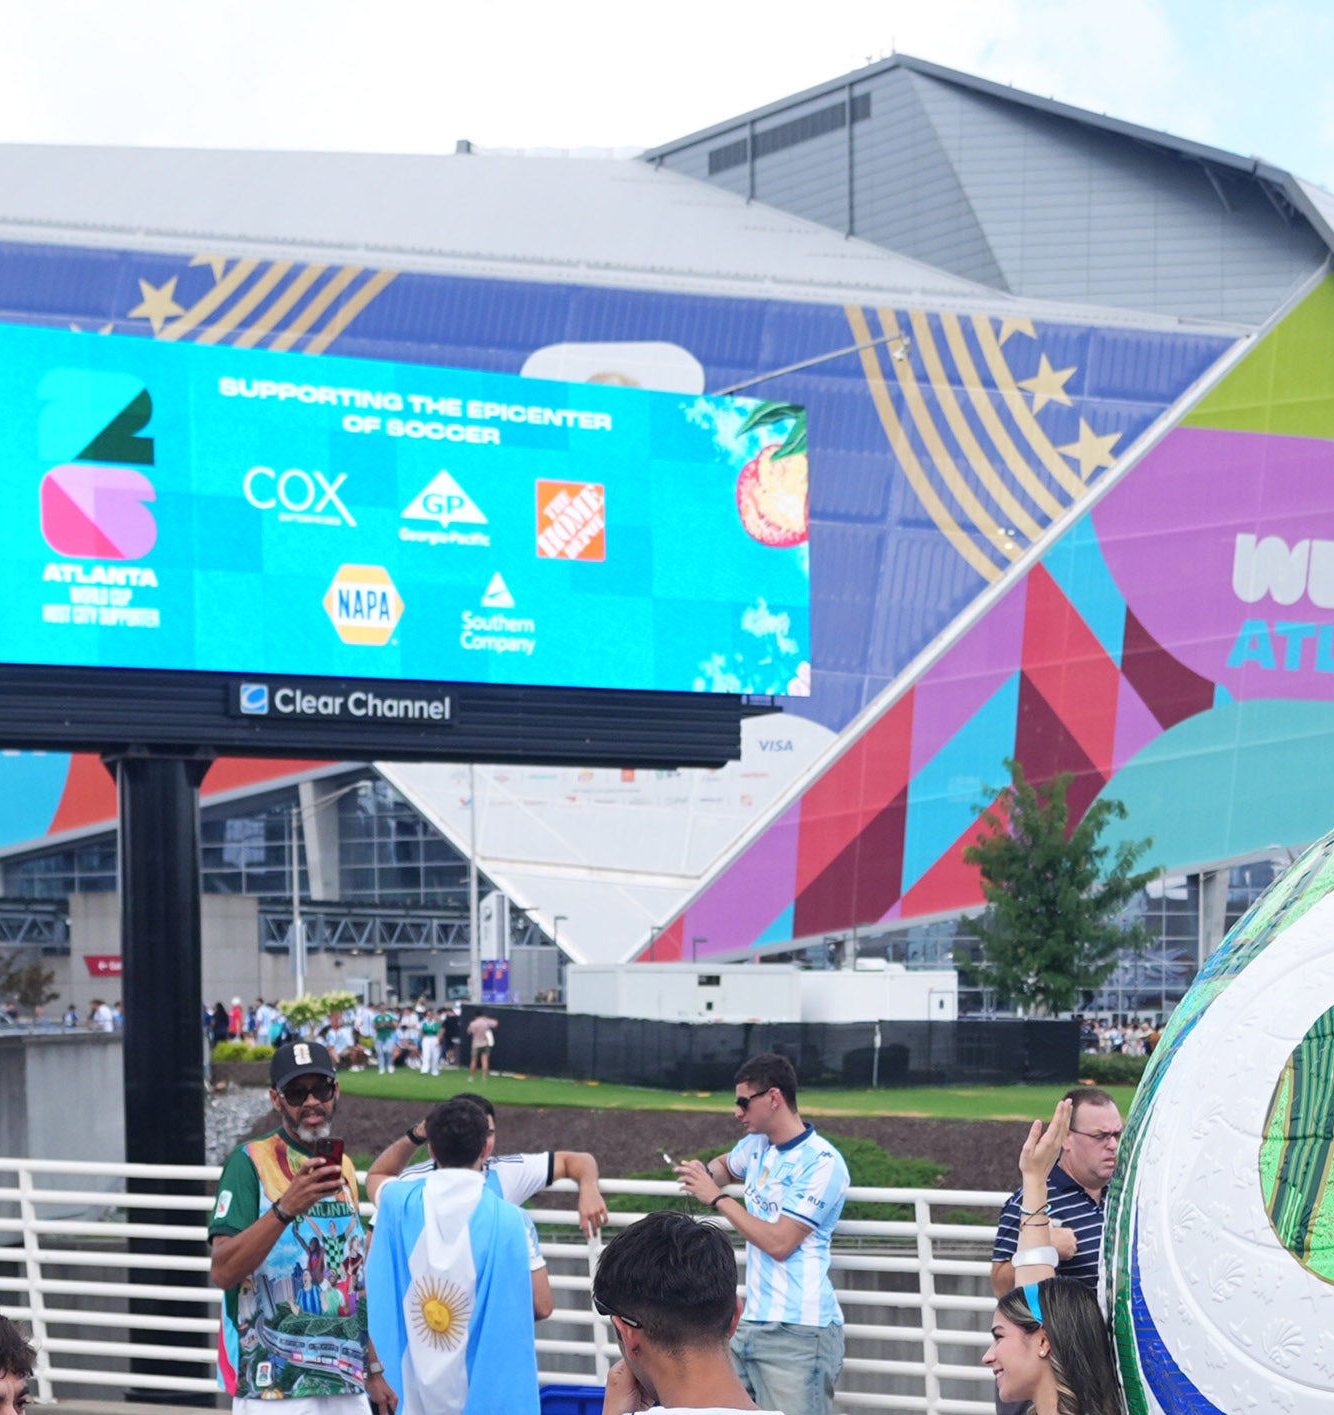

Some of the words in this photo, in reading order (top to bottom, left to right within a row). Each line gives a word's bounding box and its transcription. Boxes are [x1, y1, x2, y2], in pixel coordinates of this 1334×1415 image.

[218, 377, 402, 413] SUPPORTING
[407, 395, 462, 417] THE
[467, 401, 612, 431] EPICENTER
[342, 415, 381, 434] OF
[386, 418, 500, 445] SOCCER
[243, 465, 357, 527] COX
[422, 493, 464, 515] GP
[537, 483, 605, 558] HOME
[42, 562, 158, 587] ATLANTA
[338, 589, 390, 622] NAPA
[461, 611, 535, 633] Southern
[460, 632, 535, 656] Company
[275, 688, 342, 716] Clear
[348, 692, 450, 720] Channel
[759, 740, 794, 752] VISA
[306, 1201, 352, 1218] ATLANTA
[808, 1195, 826, 1210] RUS
